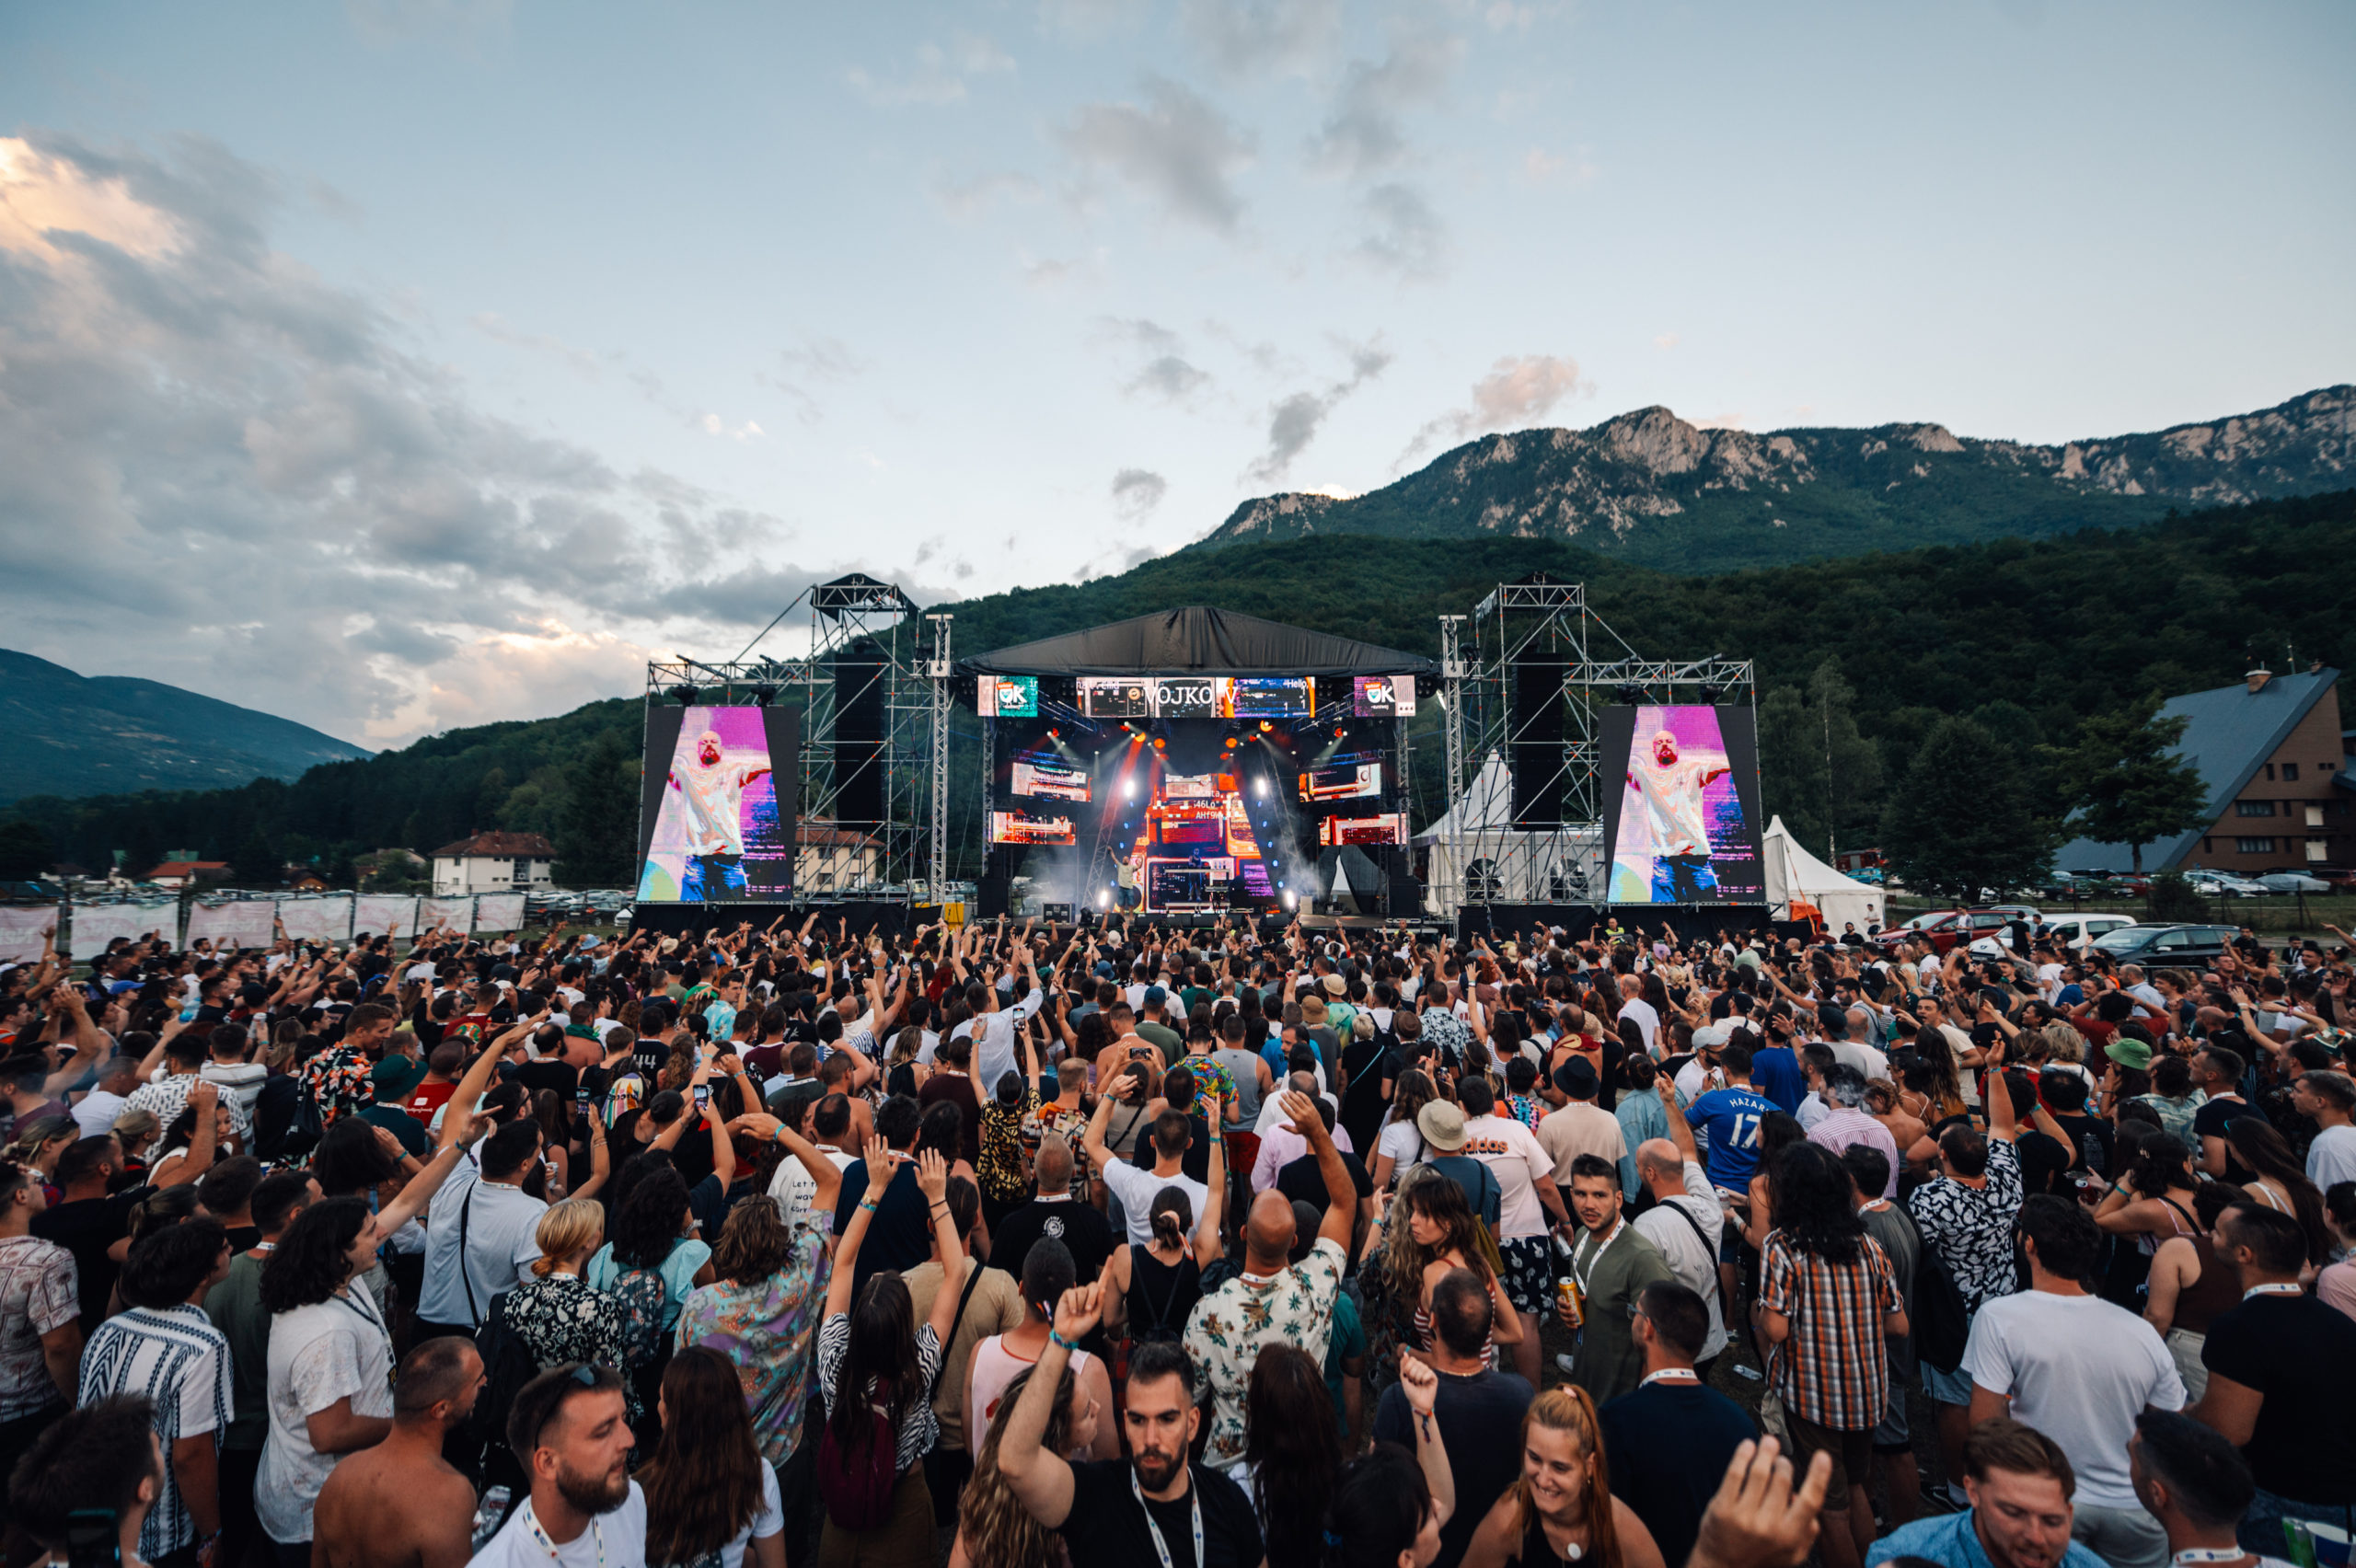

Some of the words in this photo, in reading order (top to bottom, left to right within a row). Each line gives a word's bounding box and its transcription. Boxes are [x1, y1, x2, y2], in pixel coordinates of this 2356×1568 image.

[1143, 686, 1213, 705] VOJKO
[1224, 686, 1238, 705] V
[1729, 1098, 1769, 1112] HAZAR
[1728, 1113, 1761, 1148] 17
